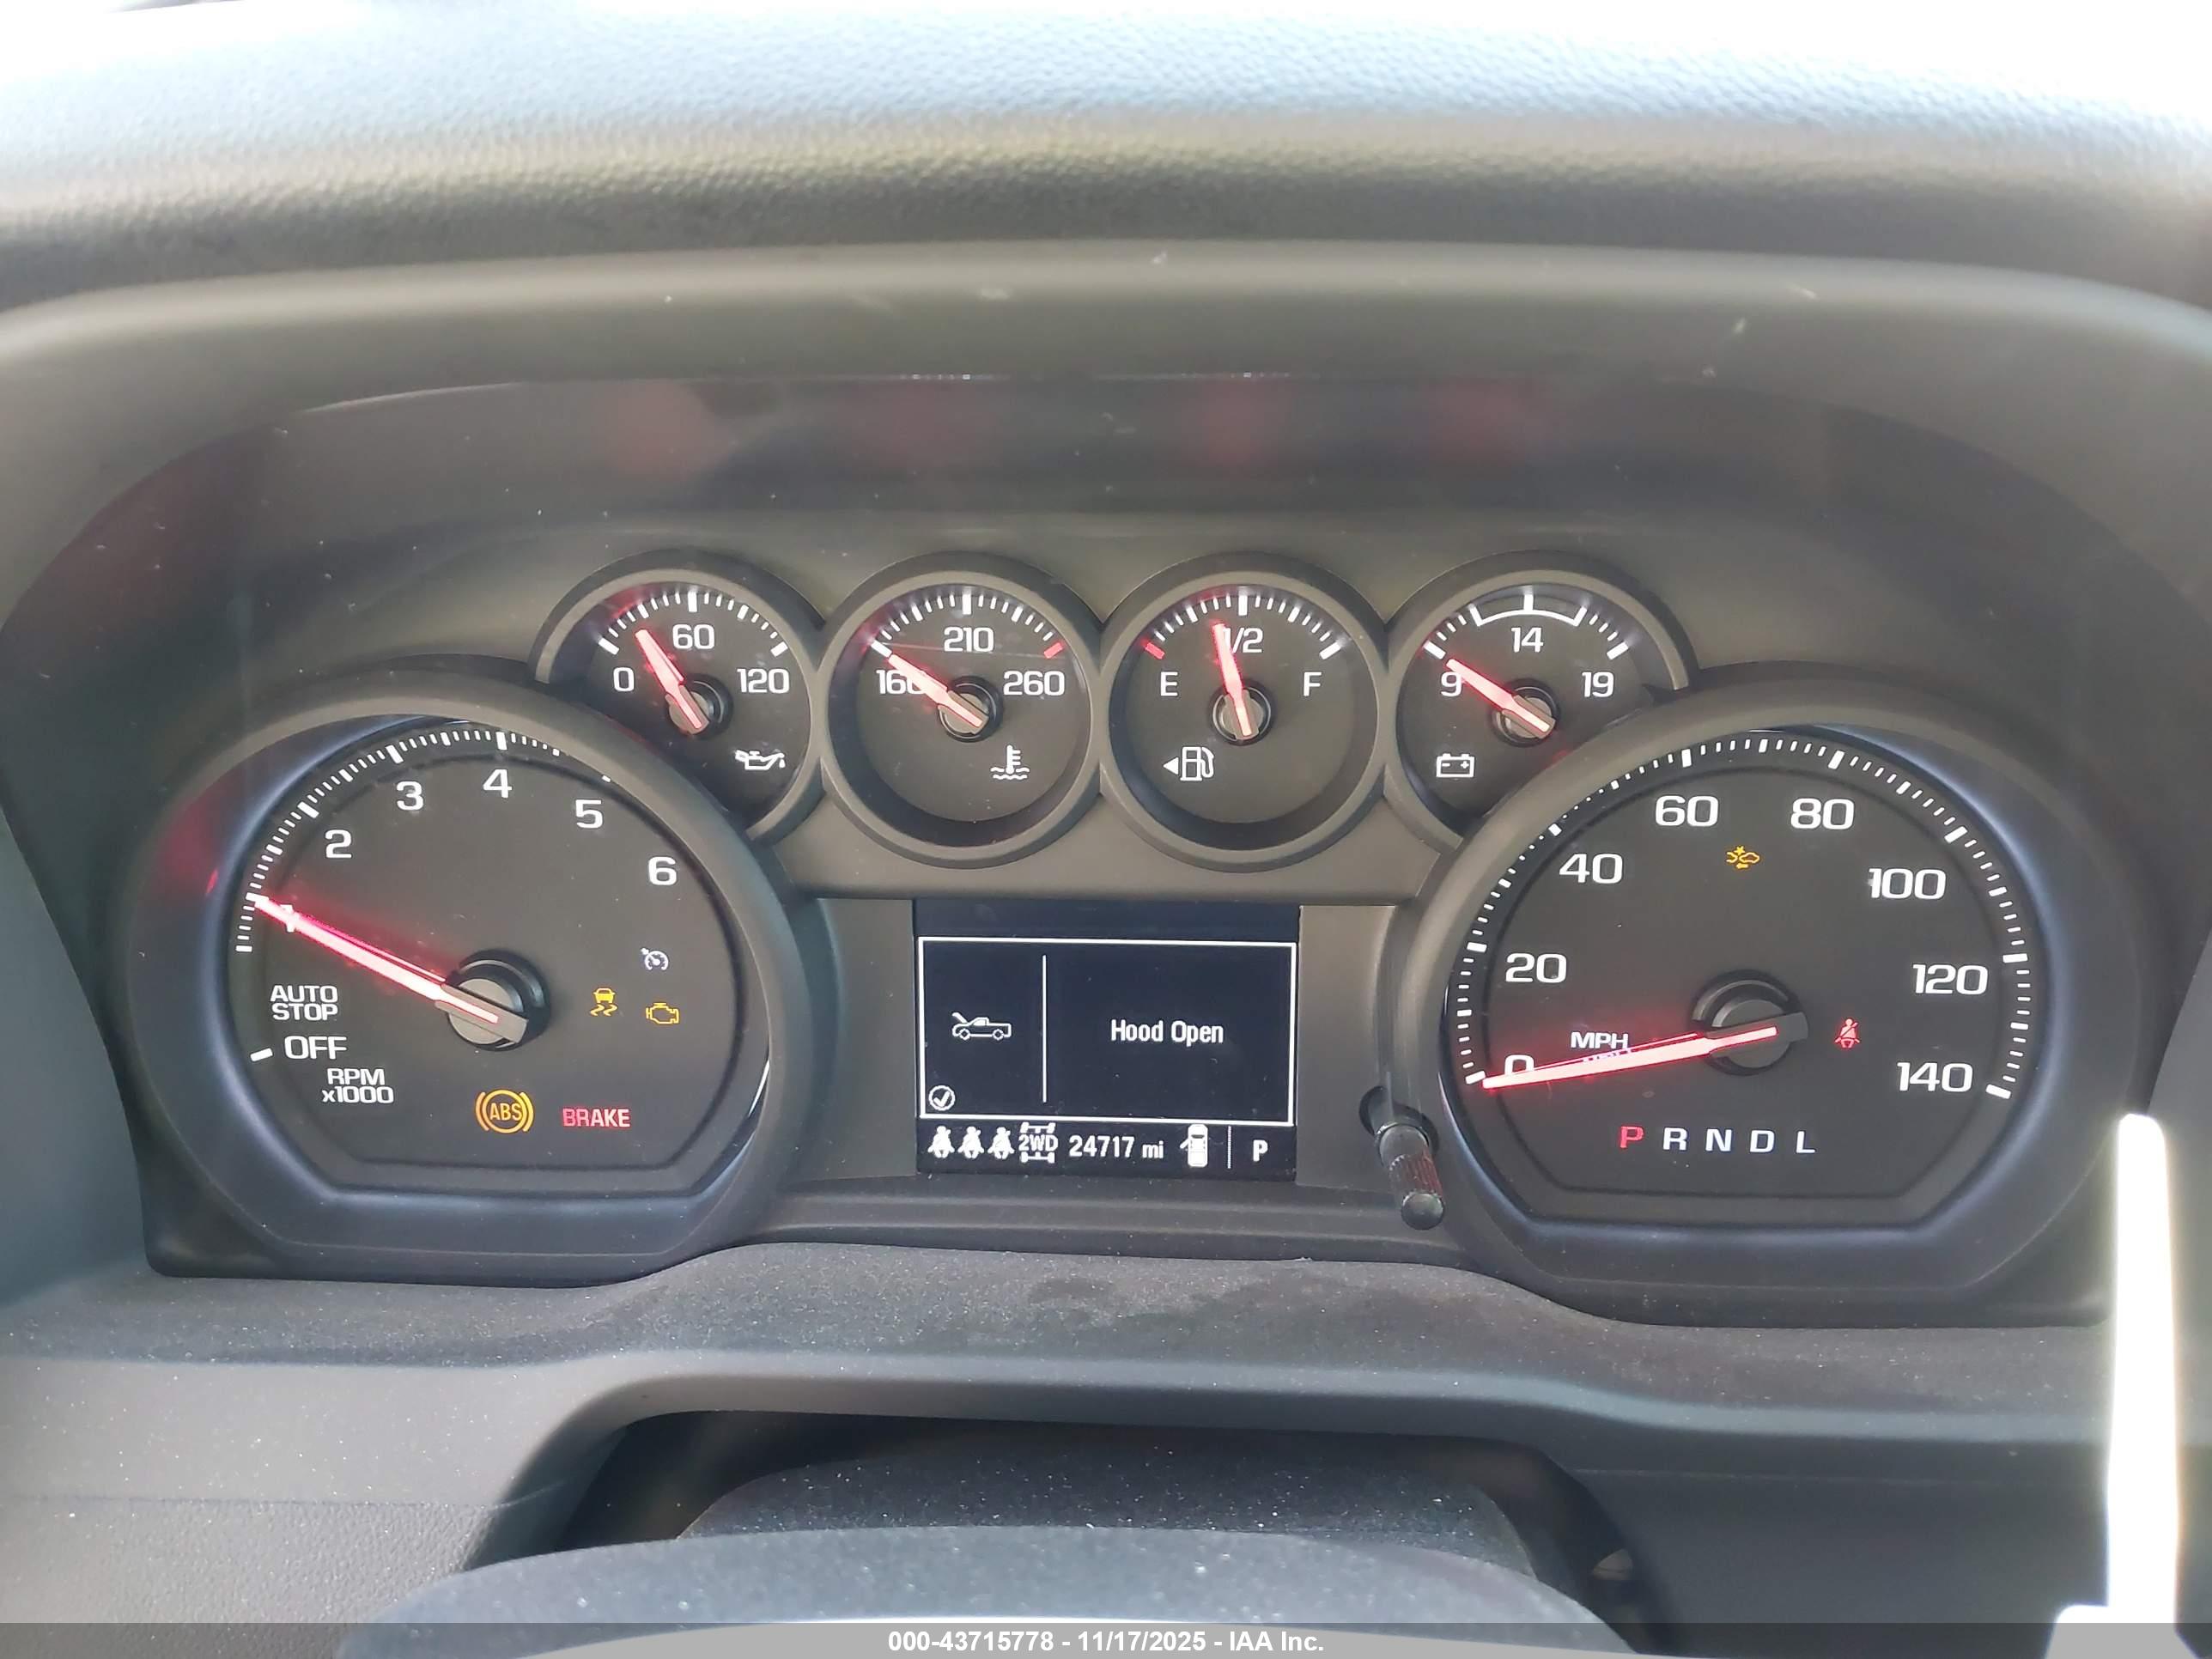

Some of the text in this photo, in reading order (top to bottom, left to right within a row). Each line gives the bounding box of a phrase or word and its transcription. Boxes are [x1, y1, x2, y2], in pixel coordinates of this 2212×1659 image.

[672, 623, 715, 650] 60
[944, 627, 994, 653] 210
[1510, 627, 1543, 653] 14
[612, 666, 635, 692] 0
[738, 666, 789, 693] 120
[1003, 670, 1065, 696] 260
[1160, 672, 1178, 696] E
[1302, 672, 1321, 696] F
[1440, 672, 1462, 696] 9
[1582, 672, 1614, 696] 19
[396, 781, 423, 811] 3
[483, 769, 512, 799] 4
[574, 799, 603, 829] 5
[1655, 795, 1719, 827] 60
[1790, 798, 1855, 830] 80
[325, 830, 352, 860] 2
[647, 855, 677, 886] 6
[1559, 853, 1624, 884] 40
[1868, 867, 1947, 900] 100
[1504, 952, 1567, 984] 20
[1912, 963, 1989, 995] 120
[270, 985, 338, 1002] AUTO
[272, 1003, 338, 1021] STOP
[1110, 1019, 1224, 1047] Hood Open
[1570, 1031, 1629, 1049] MPH
[284, 1036, 347, 1060] OFF
[326, 1068, 385, 1086] RPM
[1897, 1062, 1973, 1094] 140
[321, 1086, 394, 1104] x1000
[489, 1102, 522, 1121] ABS
[562, 1108, 630, 1127] BRAKE
[1018, 1133, 1059, 1152] 2WD
[1068, 1135, 1164, 1158] 24717 mi
[1252, 1139, 1268, 1163] P
[1620, 1126, 1816, 1153] P R N D L
